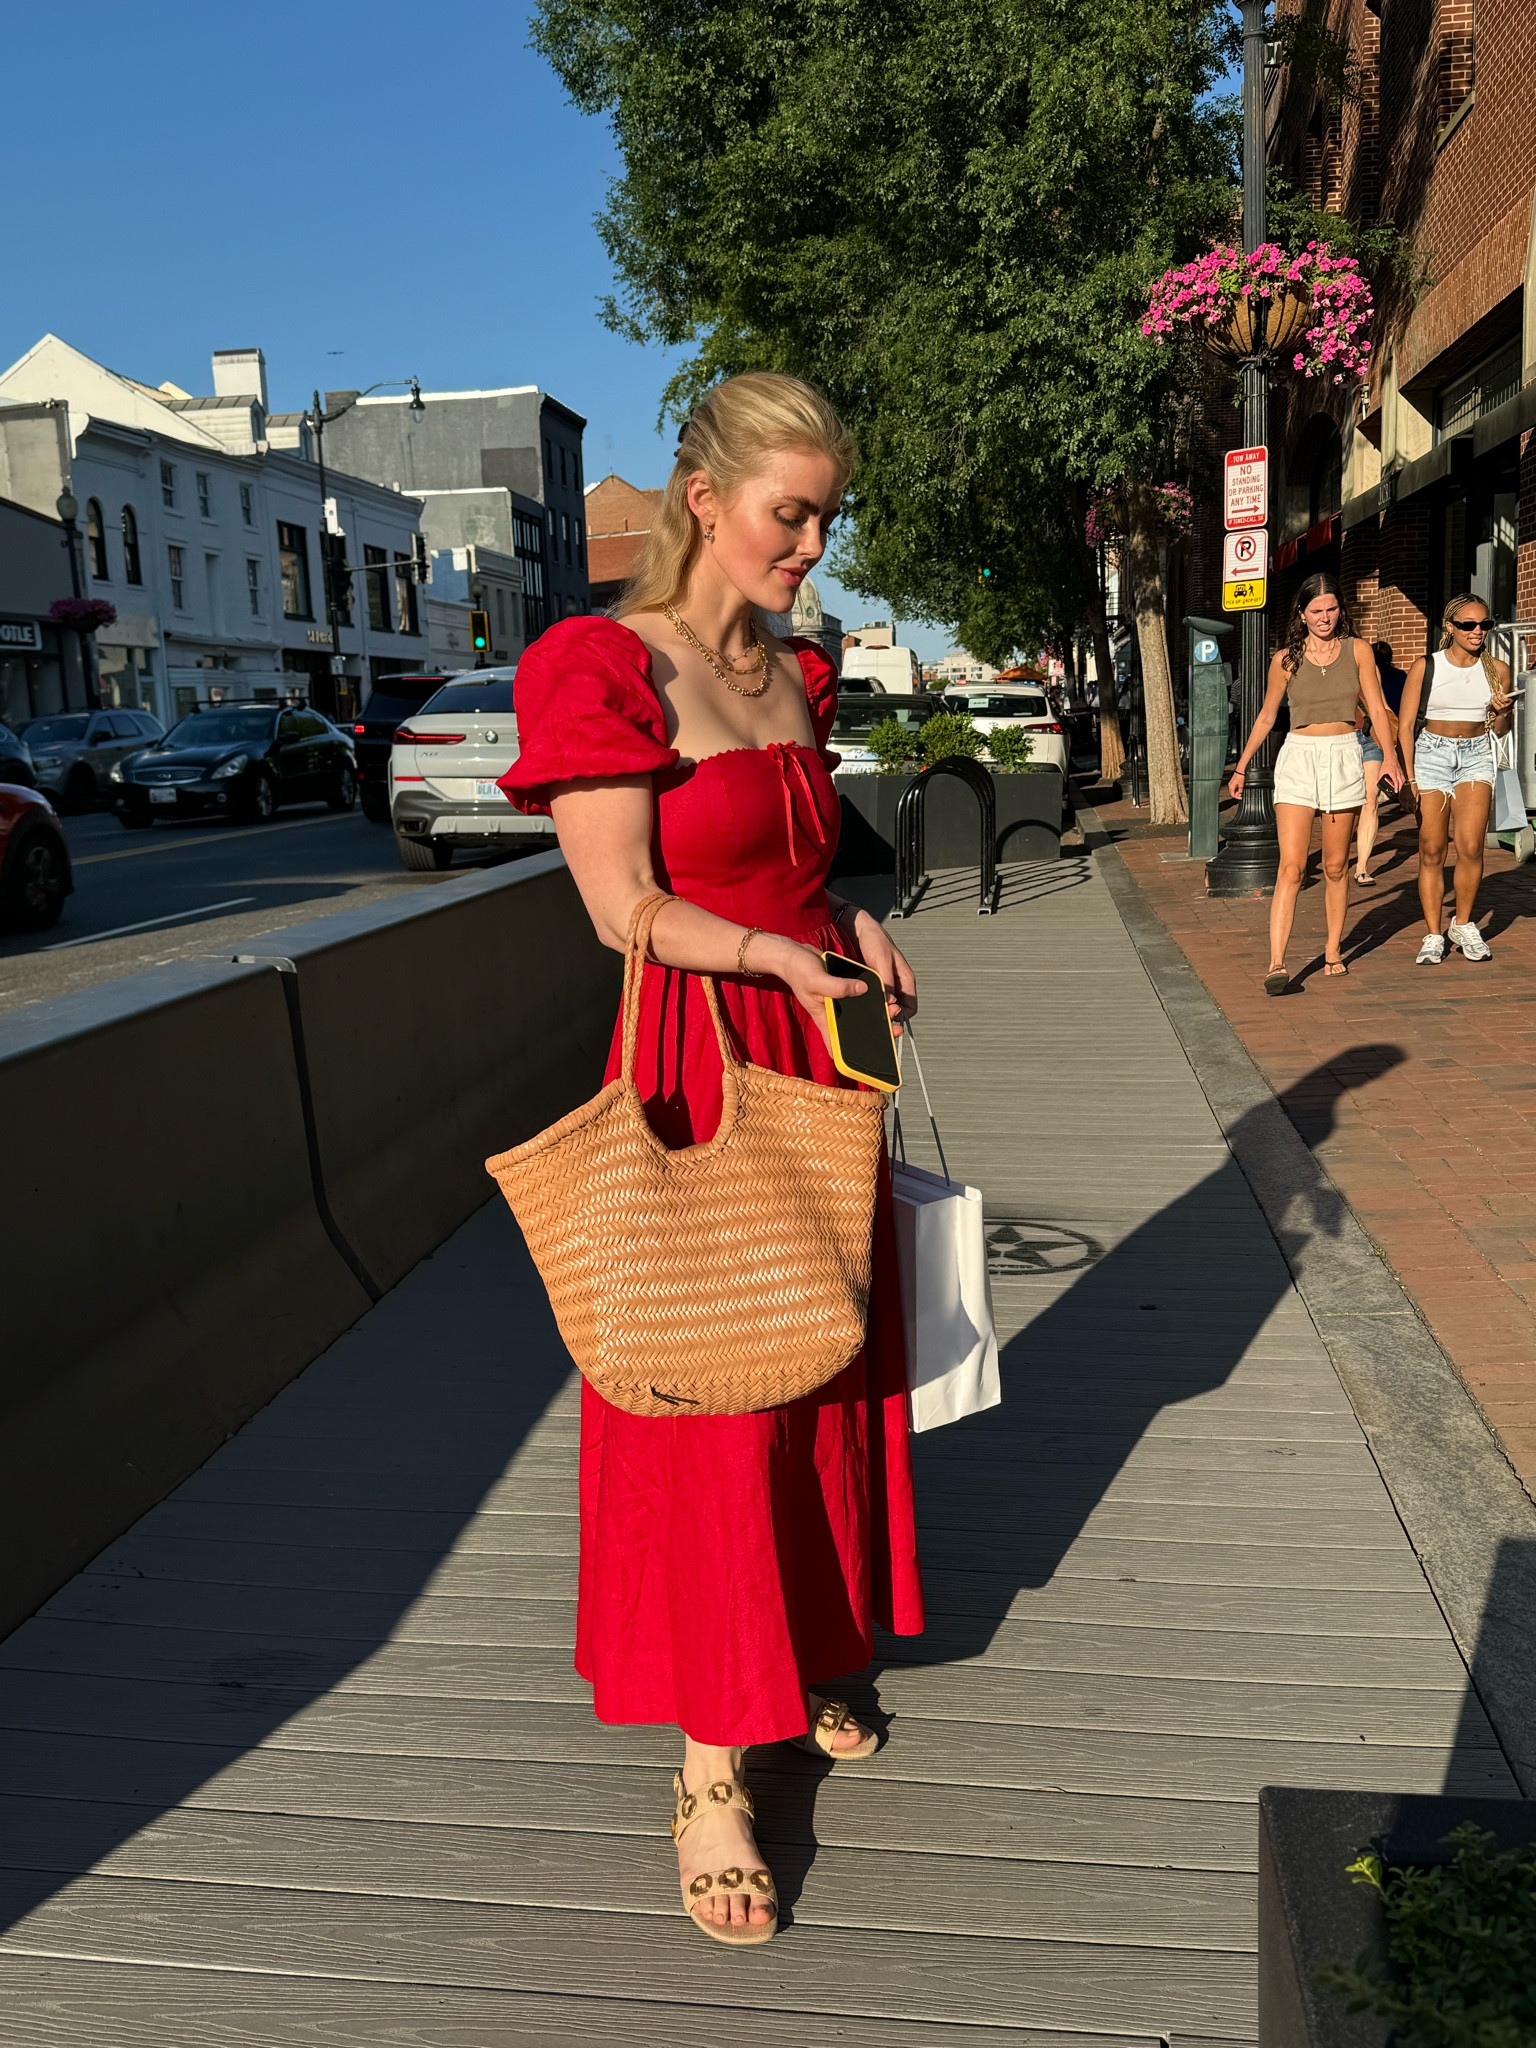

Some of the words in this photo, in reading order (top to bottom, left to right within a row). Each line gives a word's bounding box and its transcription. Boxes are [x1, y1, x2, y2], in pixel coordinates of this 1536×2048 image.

[1233, 455, 1244, 463] TOW
[1245, 452, 1260, 461] AWAY
[1240, 465, 1252, 475] NO
[1232, 475, 1260, 486] STANDING
[1229, 488, 1236, 497] OR
[1238, 484, 1263, 495] PARKING
[1231, 497, 1244, 506] ANY
[1246, 494, 1261, 504] TIME
[1201, 640, 1216, 662] P
